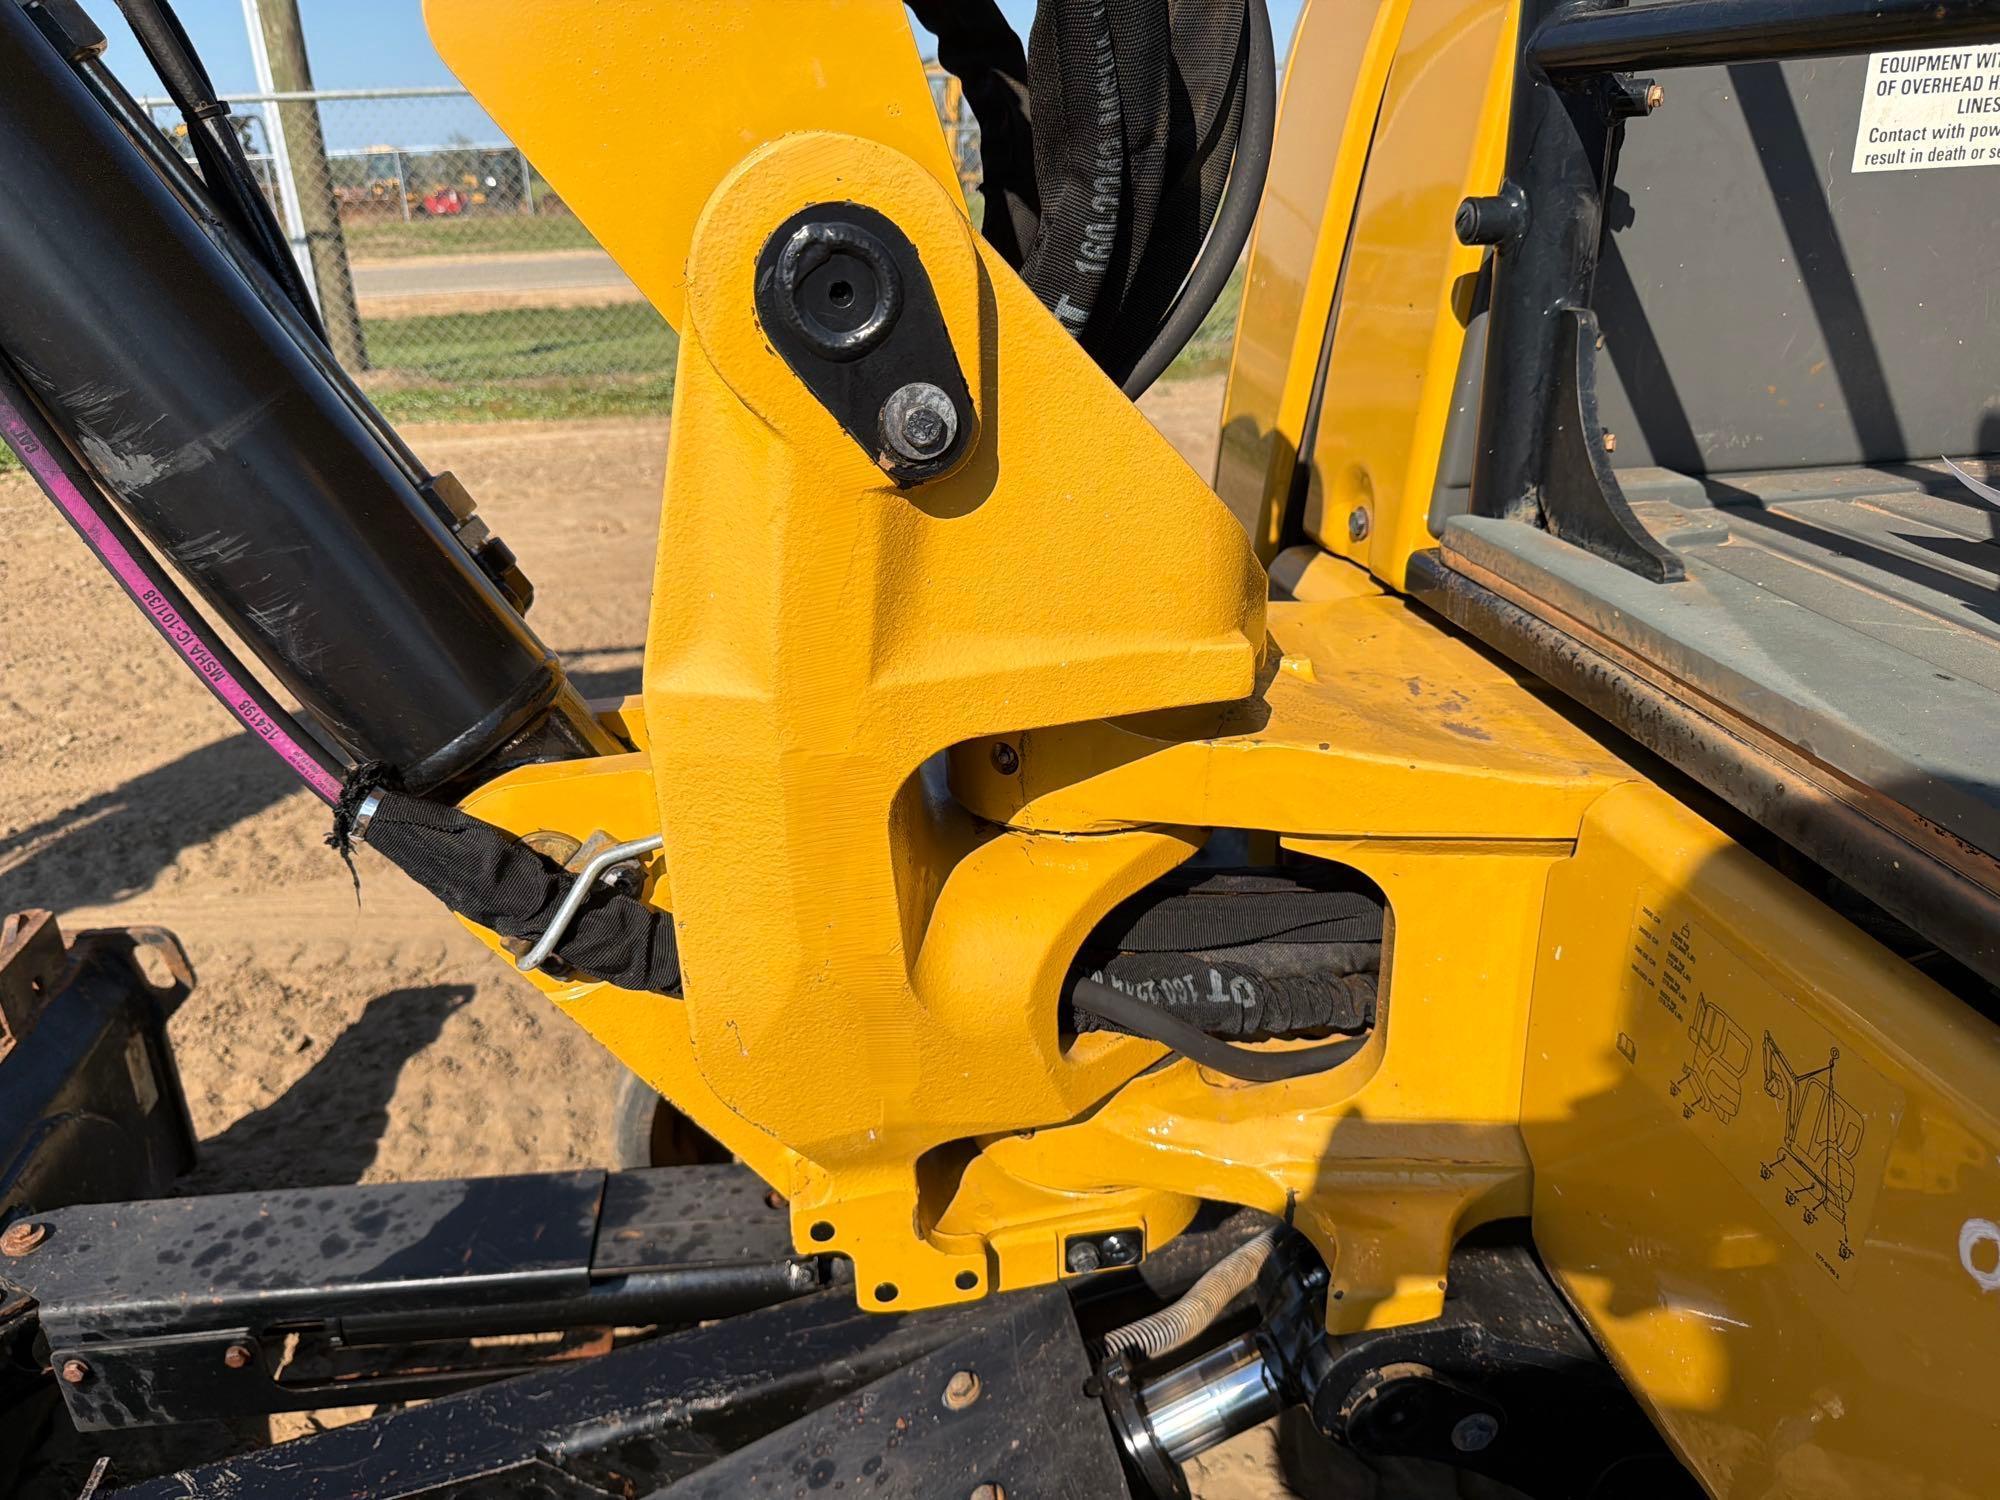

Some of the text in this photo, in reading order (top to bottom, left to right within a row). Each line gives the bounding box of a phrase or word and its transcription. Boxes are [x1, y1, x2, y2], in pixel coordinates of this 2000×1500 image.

[1880, 53, 1972, 74] EQUIPMENT
[1876, 74, 2000, 96] OF OVERHEAD H
[1957, 97, 2000, 114] LINES
[1869, 127, 1927, 143] Contact
[1932, 123, 1965, 140] with
[1864, 148, 1906, 166] result
[1910, 148, 1923, 164] in
[1927, 145, 1966, 163] death
[1970, 148, 1985, 160] or
[142, 589, 279, 740] 1E4198 MSHA IC-101/38
